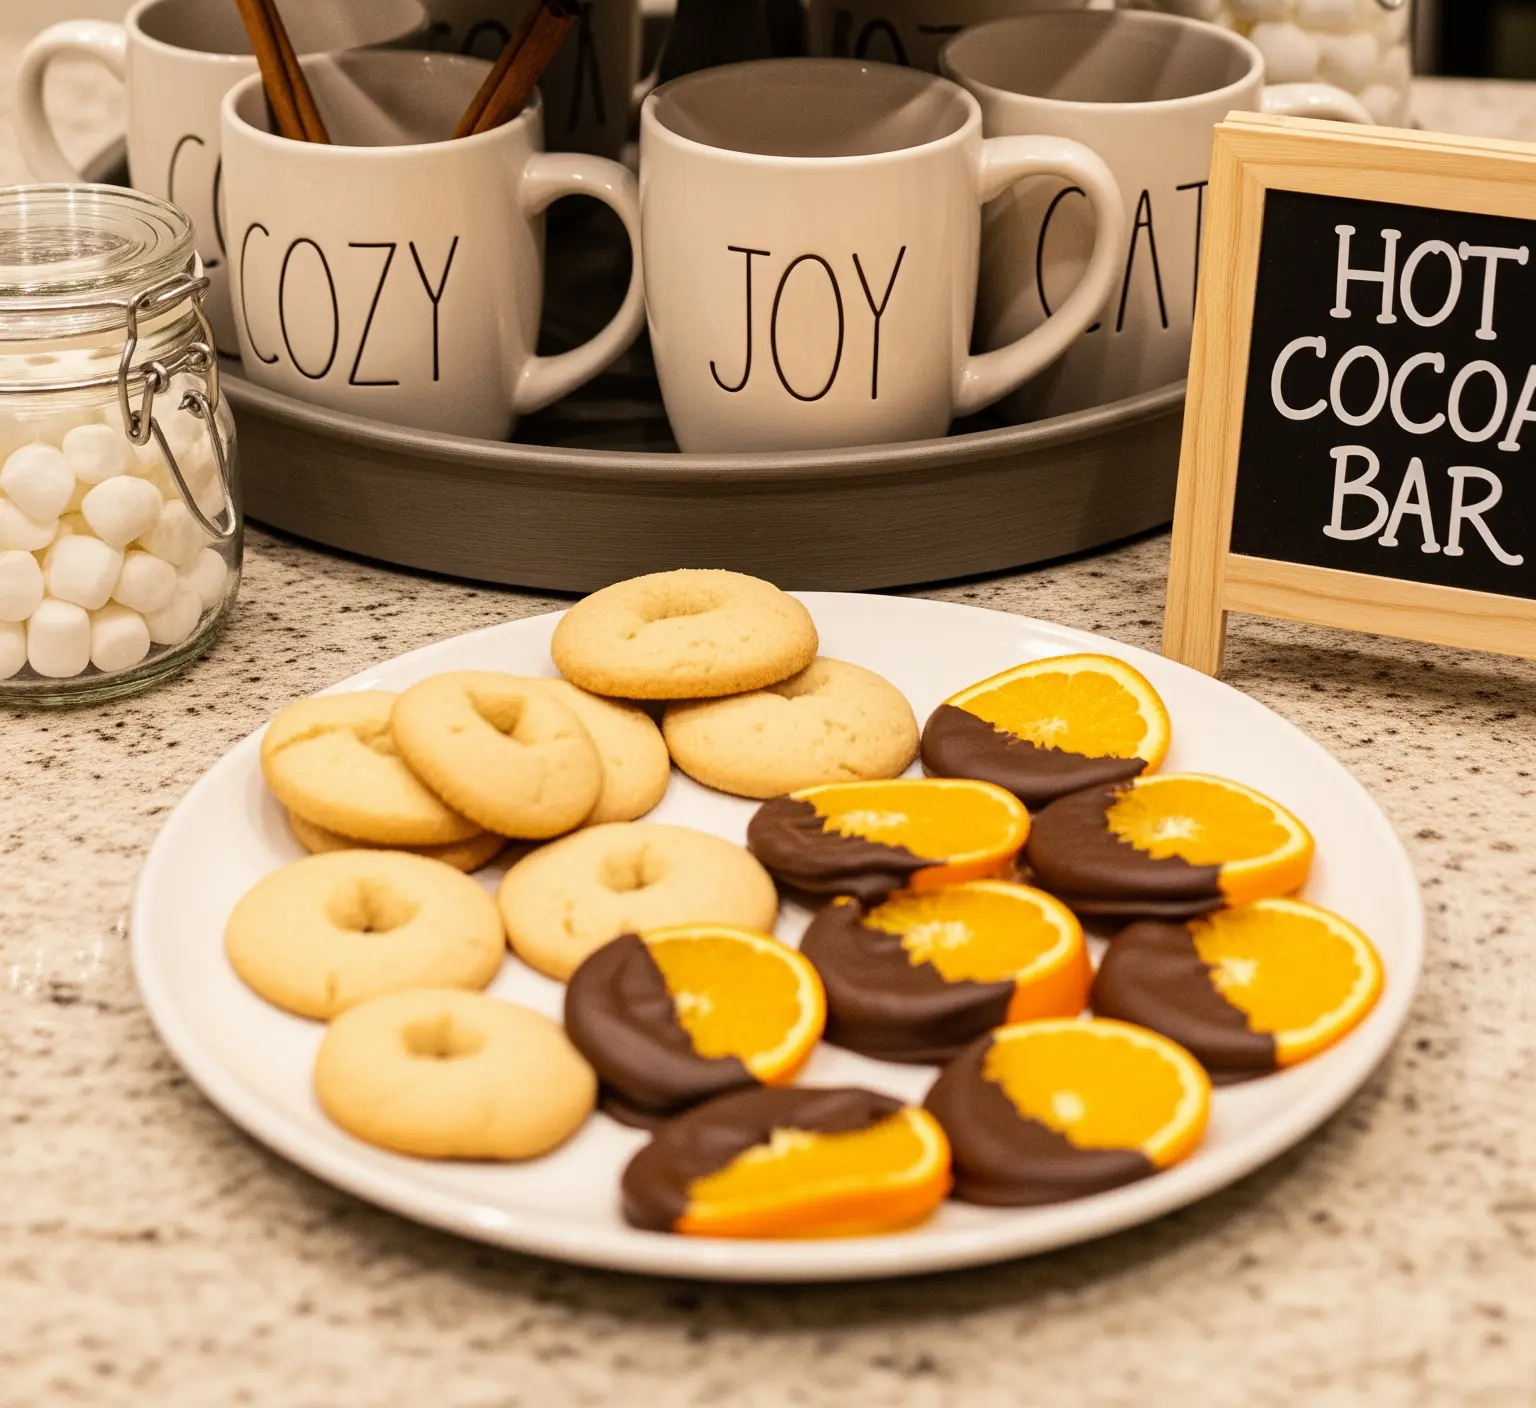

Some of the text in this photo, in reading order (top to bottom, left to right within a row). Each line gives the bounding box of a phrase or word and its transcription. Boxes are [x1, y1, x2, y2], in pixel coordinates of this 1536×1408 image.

[240, 222, 459, 387] COZY
[709, 245, 906, 402] JOY
[1036, 180, 1208, 334] CAT
[1329, 224, 1529, 340] HOT
[1323, 445, 1523, 566] BAR
